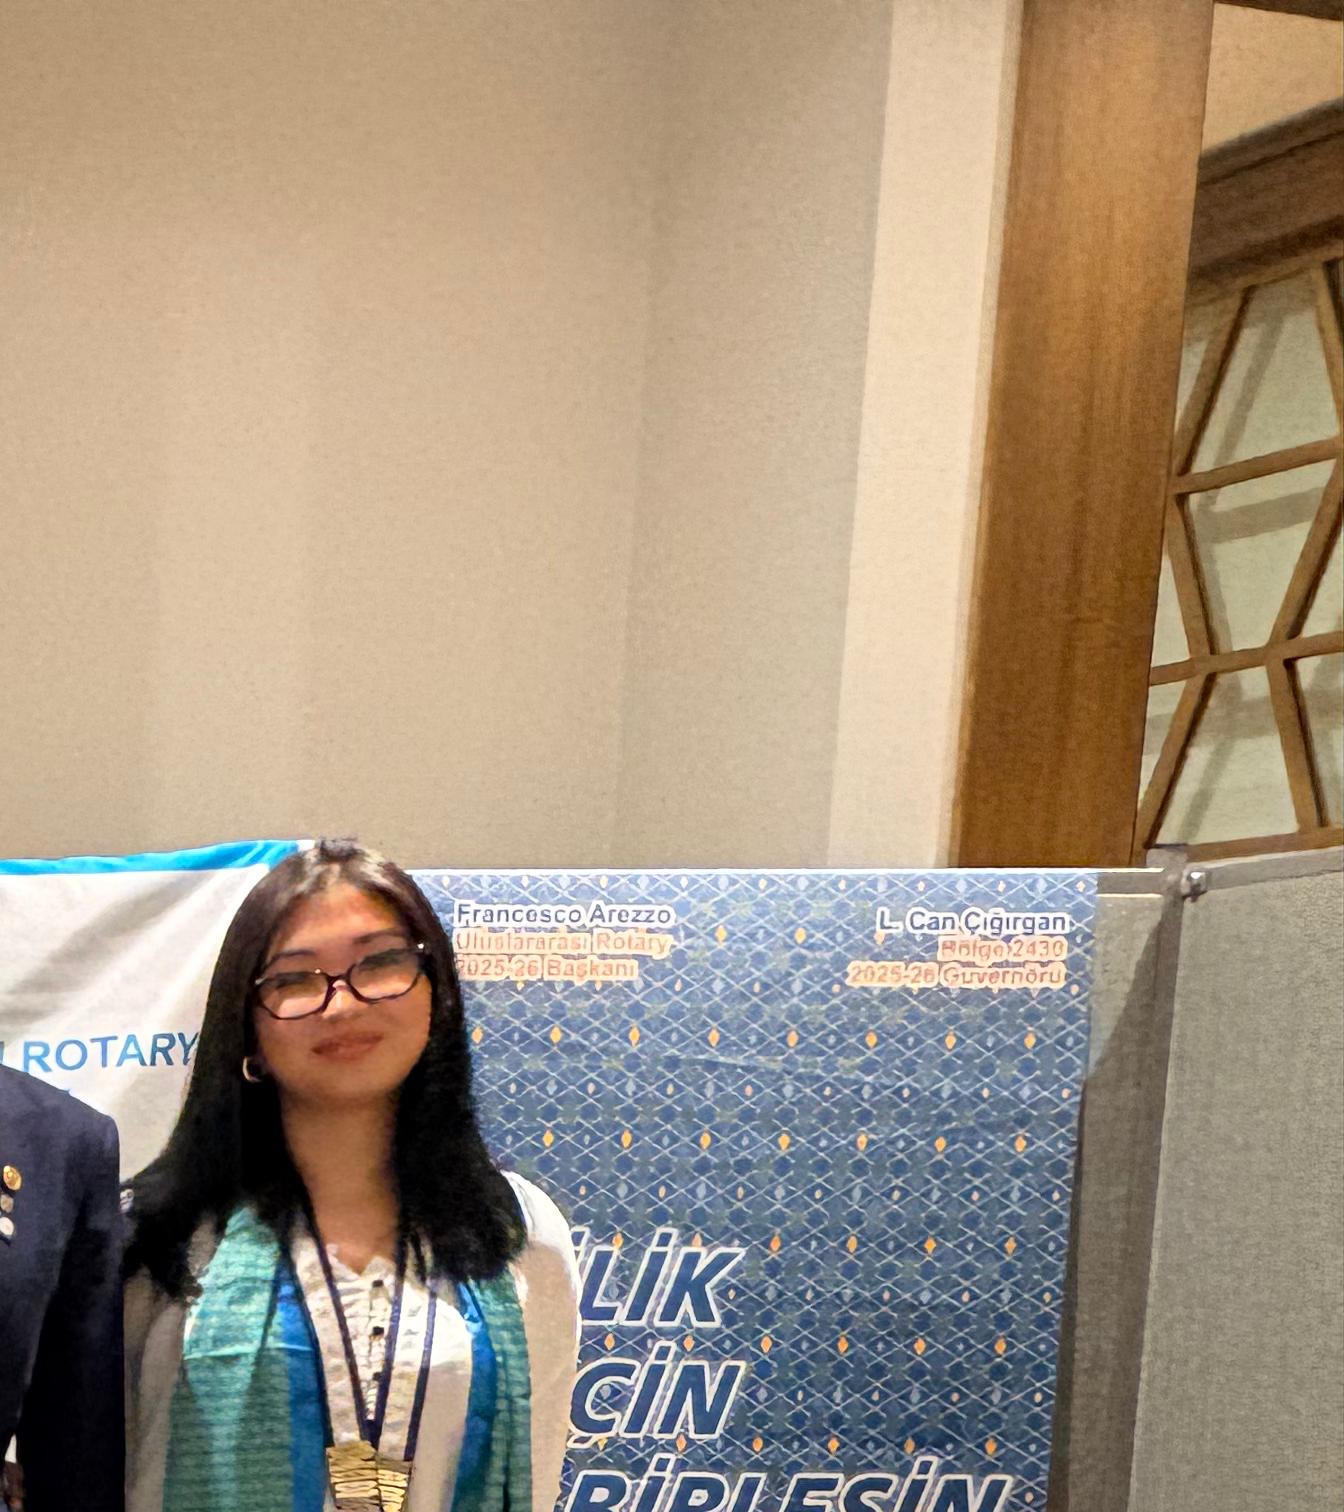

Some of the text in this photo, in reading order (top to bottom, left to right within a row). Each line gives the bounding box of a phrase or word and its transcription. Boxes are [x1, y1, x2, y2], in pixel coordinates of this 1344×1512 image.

[456, 902, 673, 925] Francesco Arezzo
[909, 910, 957, 931] Can
[595, 932, 669, 954] Rotary
[1012, 940, 1066, 958] 2430
[23, 1032, 200, 1074] ROTARY
[572, 1227, 746, 1328] LİK
